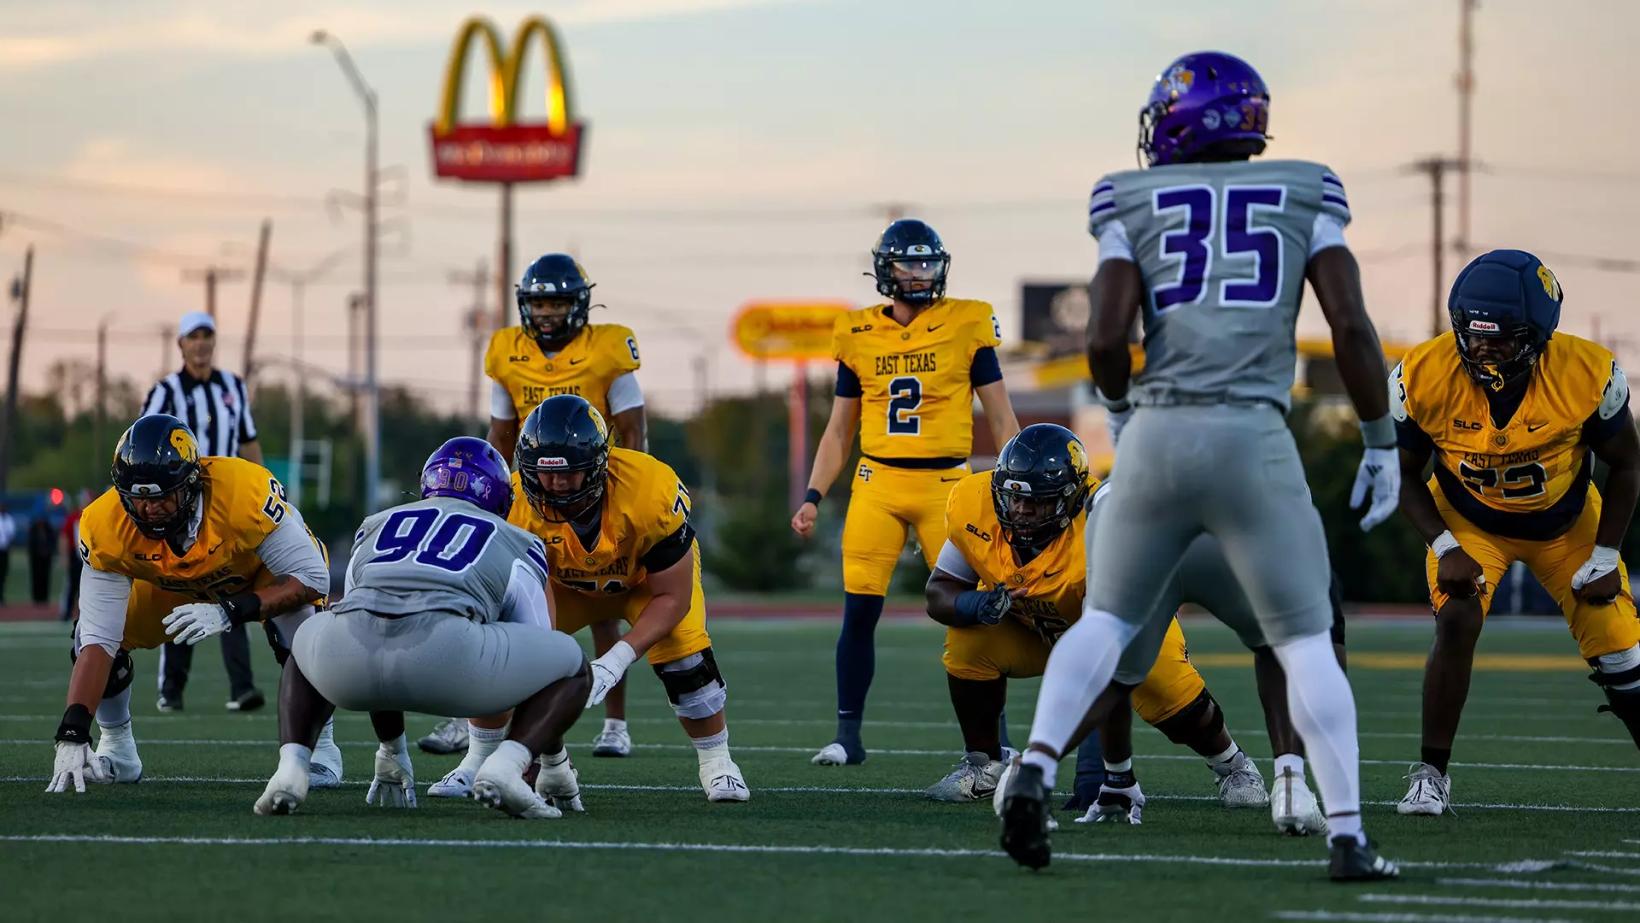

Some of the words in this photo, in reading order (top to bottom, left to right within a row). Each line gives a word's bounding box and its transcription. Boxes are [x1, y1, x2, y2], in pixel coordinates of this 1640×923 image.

[1152, 183, 1287, 315] 35
[1472, 322, 1496, 330] Riddell
[626, 336, 640, 360] 6
[875, 355, 900, 376] EAST
[903, 352, 937, 373] TEXAS
[523, 386, 544, 404] EAST
[887, 376, 922, 436] 2
[1453, 420, 1484, 431] SLC
[540, 458, 564, 466] Riddell
[439, 468, 468, 492] 90
[367, 506, 498, 573] 90
[965, 523, 992, 542] SLC
